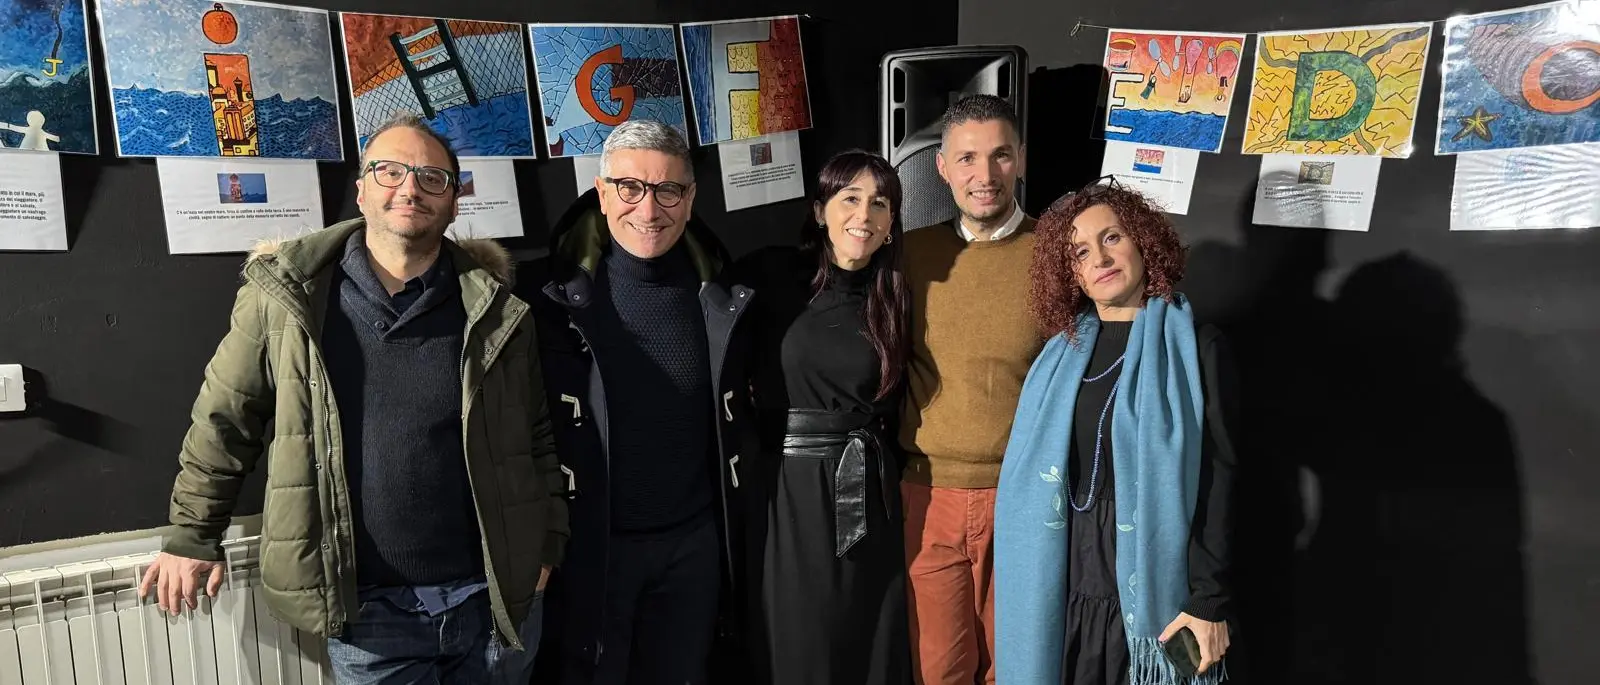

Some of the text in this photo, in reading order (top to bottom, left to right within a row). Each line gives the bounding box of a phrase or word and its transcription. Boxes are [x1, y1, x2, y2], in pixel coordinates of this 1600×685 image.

[42, 58, 64, 77] J
[575, 44, 636, 126] G
[1103, 72, 1145, 134] E
[1287, 50, 1377, 142] D
